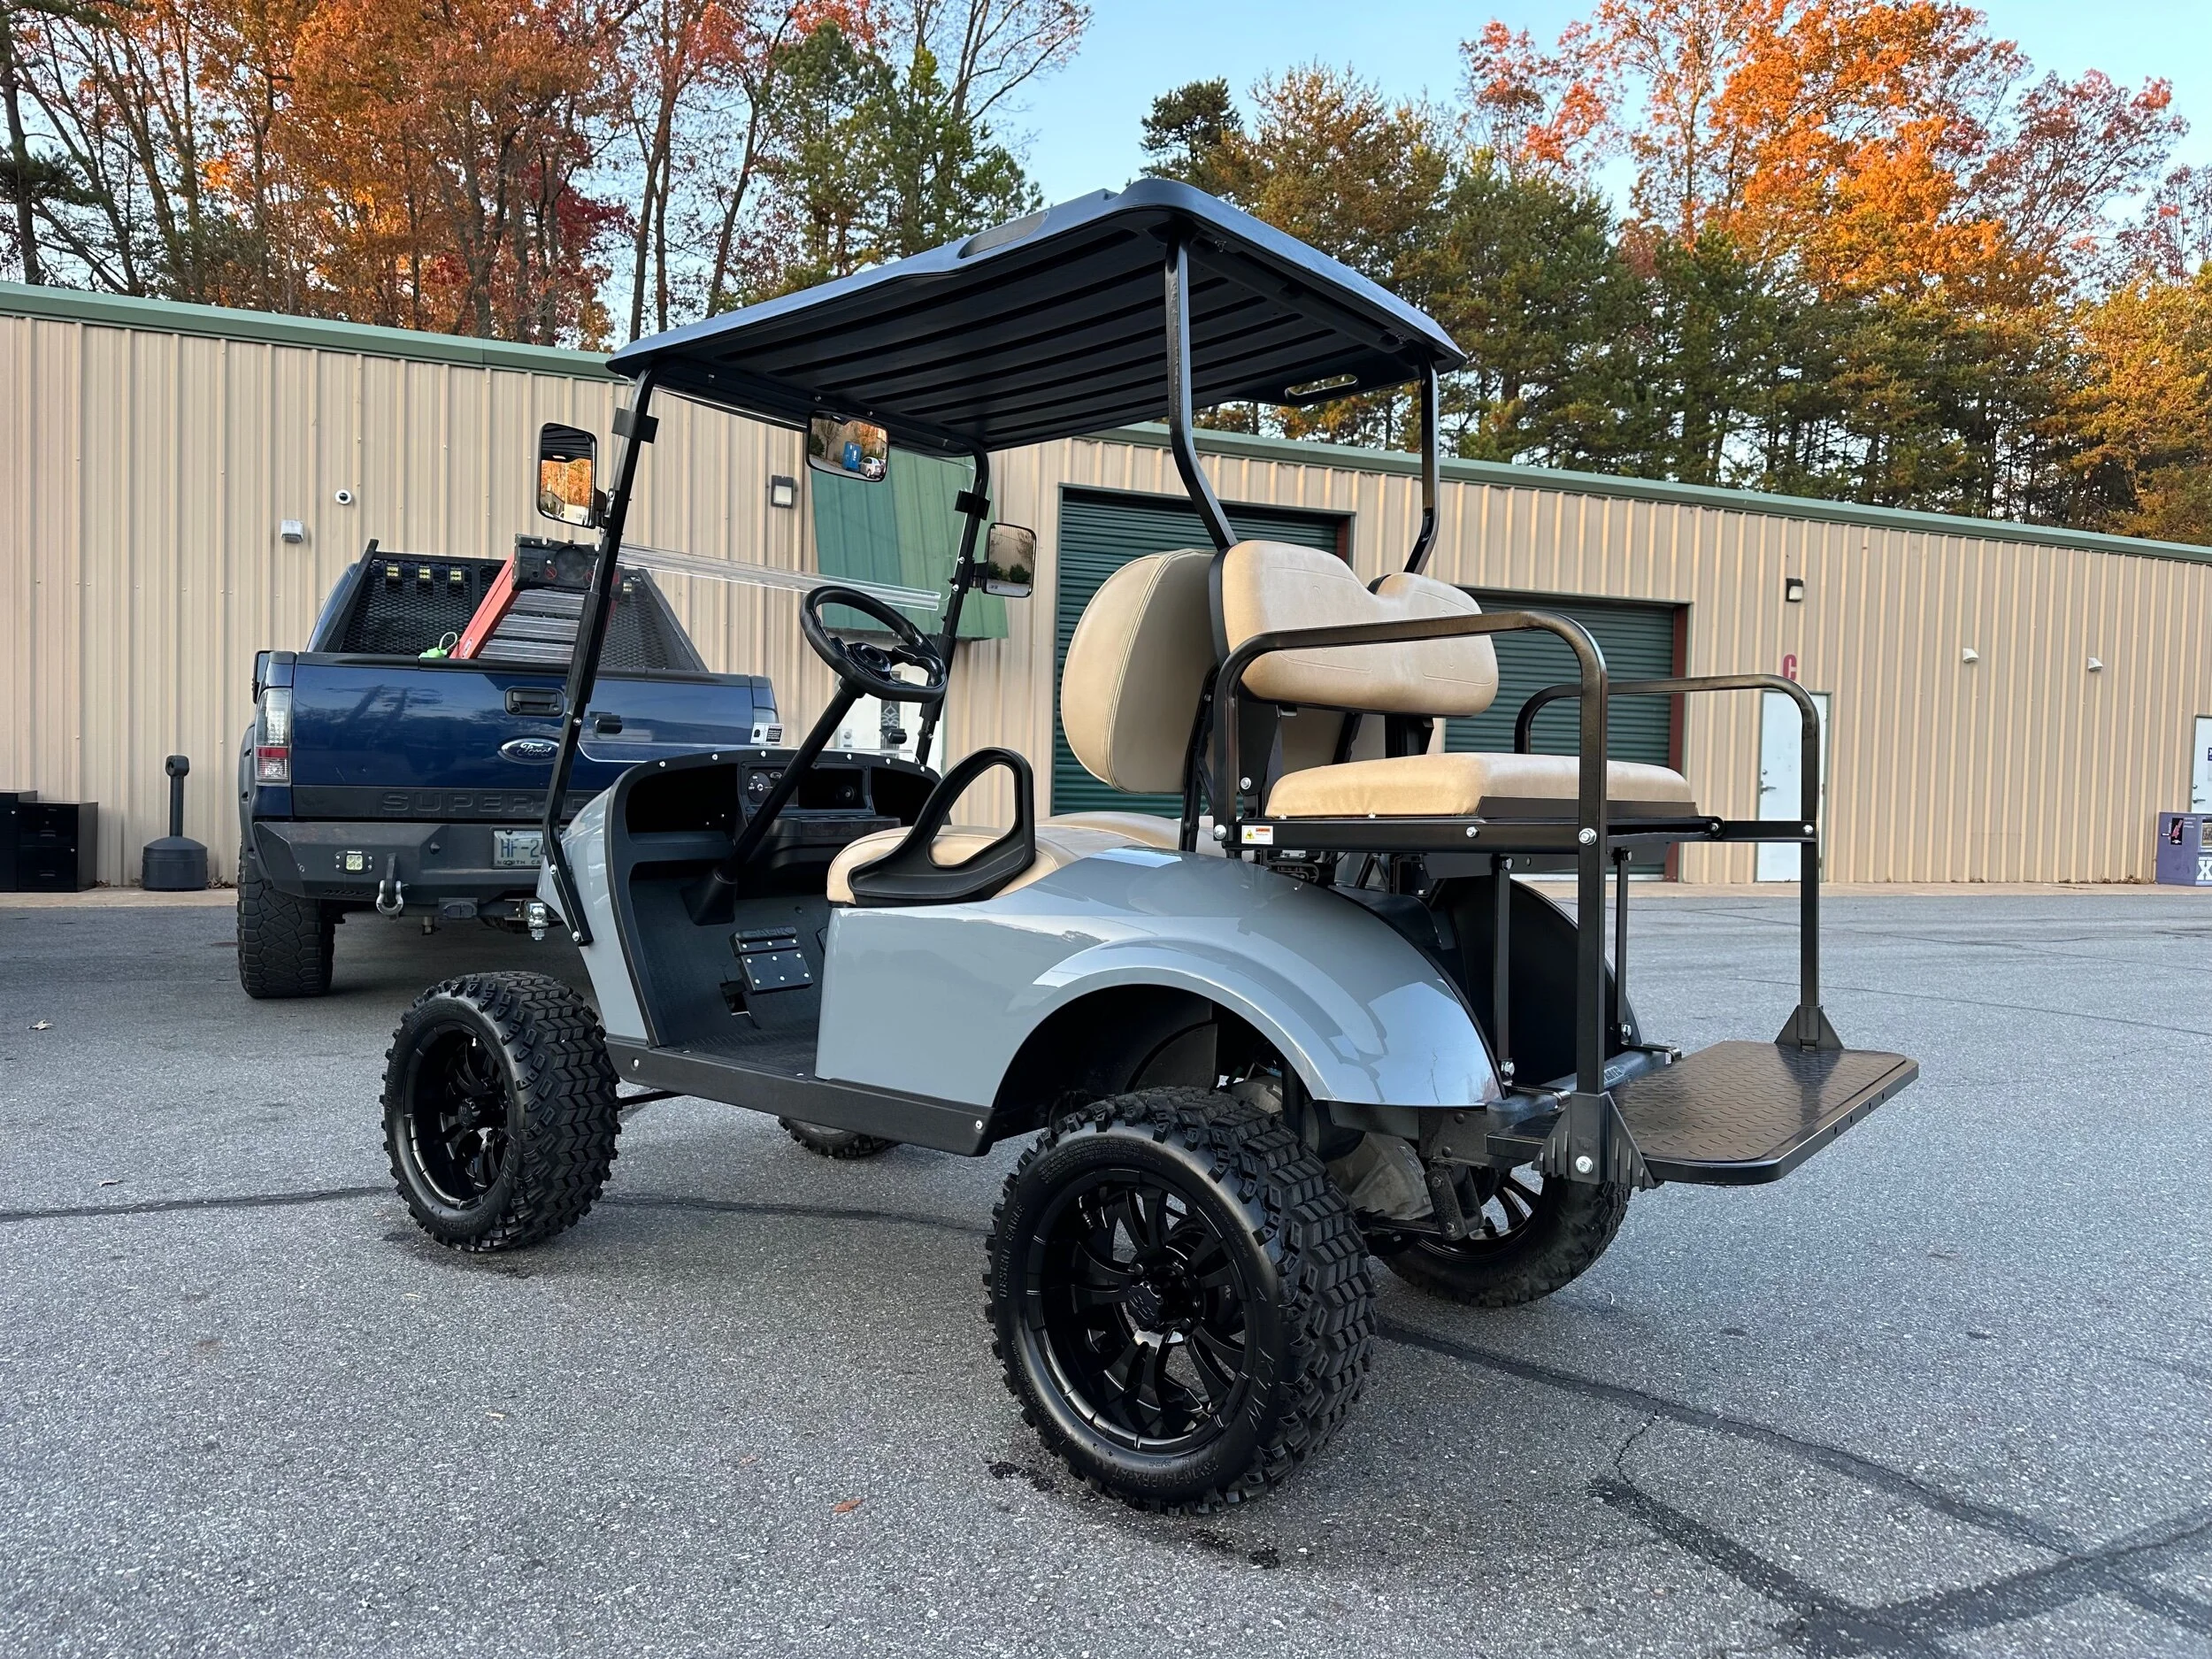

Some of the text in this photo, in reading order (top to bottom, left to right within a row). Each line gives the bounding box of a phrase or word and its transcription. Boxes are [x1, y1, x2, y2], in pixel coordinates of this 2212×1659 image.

[1783, 654, 1797, 681] C
[518, 742, 552, 755] Ford
[382, 791, 534, 813] SUPER
